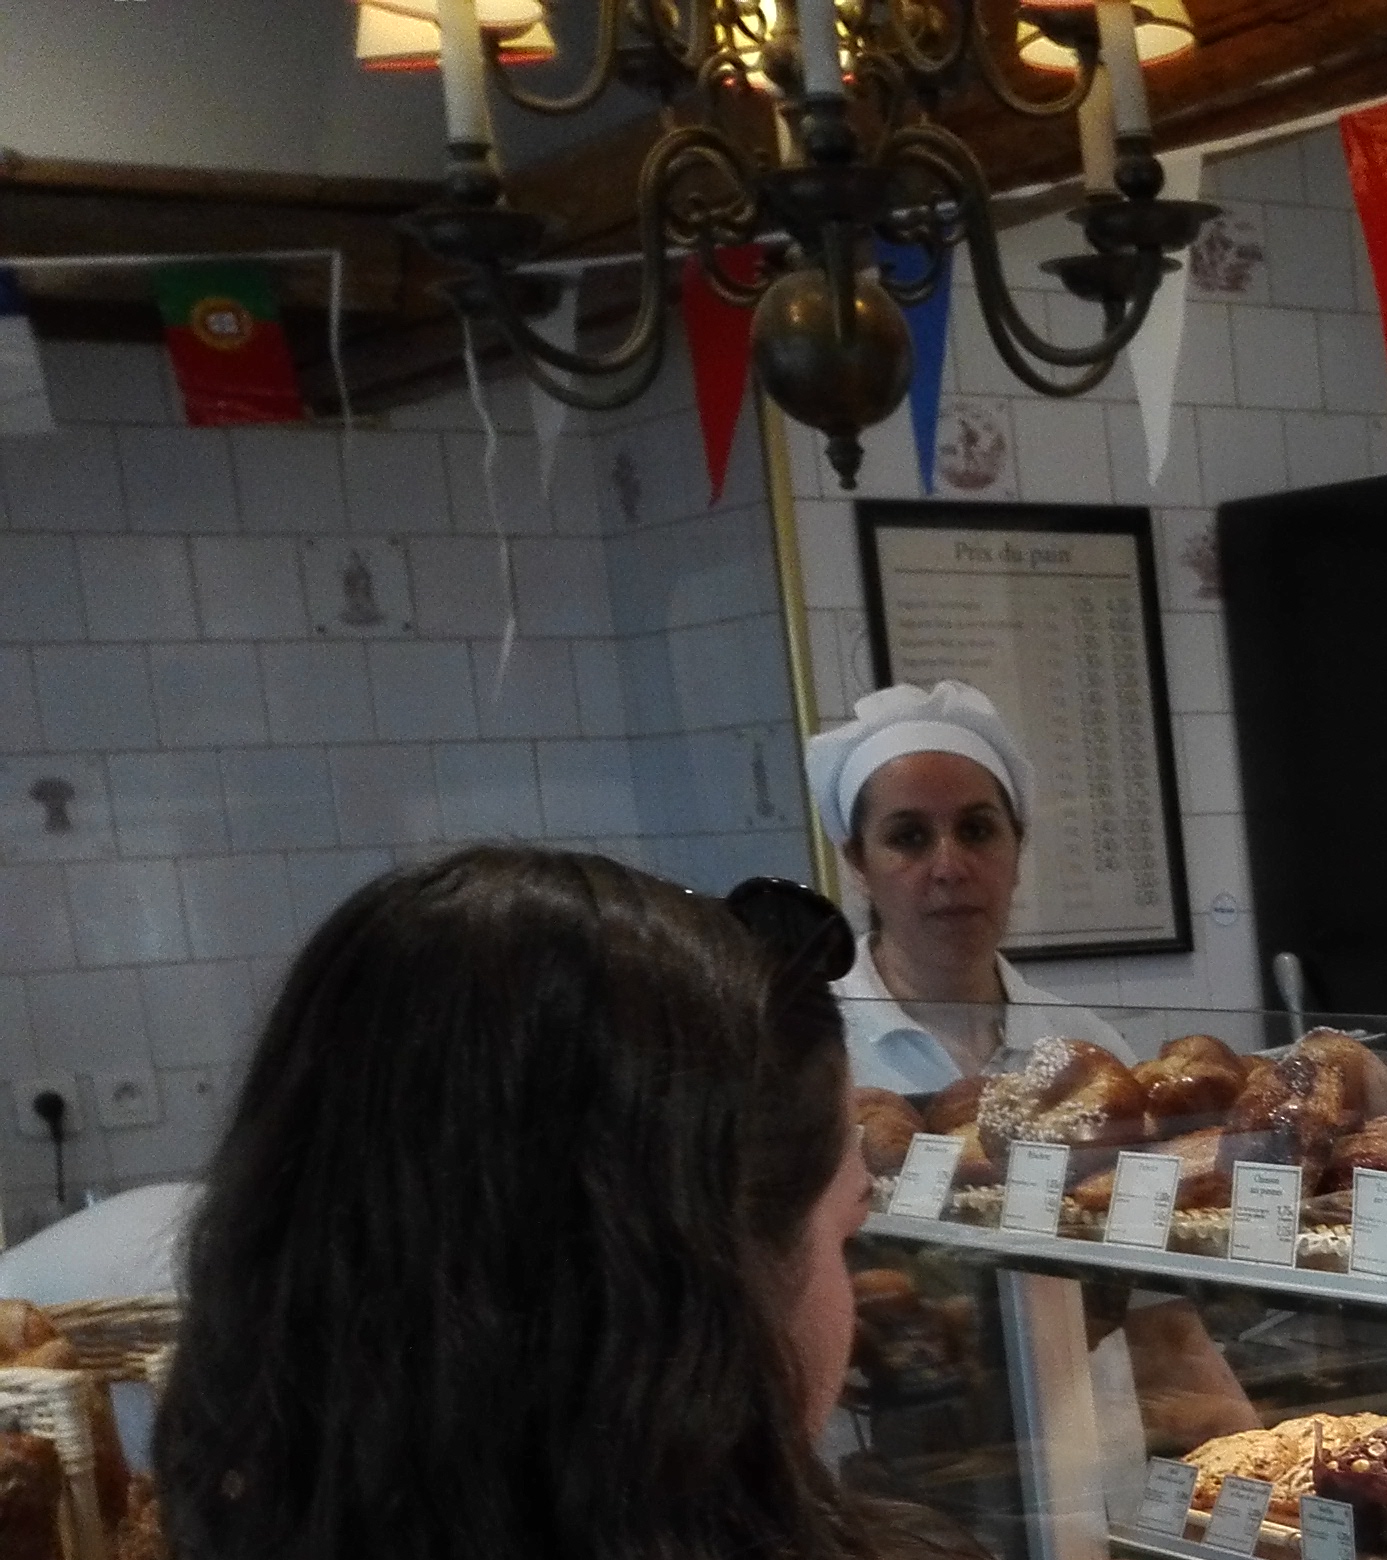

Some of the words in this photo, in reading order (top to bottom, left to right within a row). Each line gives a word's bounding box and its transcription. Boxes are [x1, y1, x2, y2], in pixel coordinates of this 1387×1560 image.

[954, 541, 993, 562] Prix
[999, 541, 1023, 562] du
[1030, 545, 1072, 569] pain
